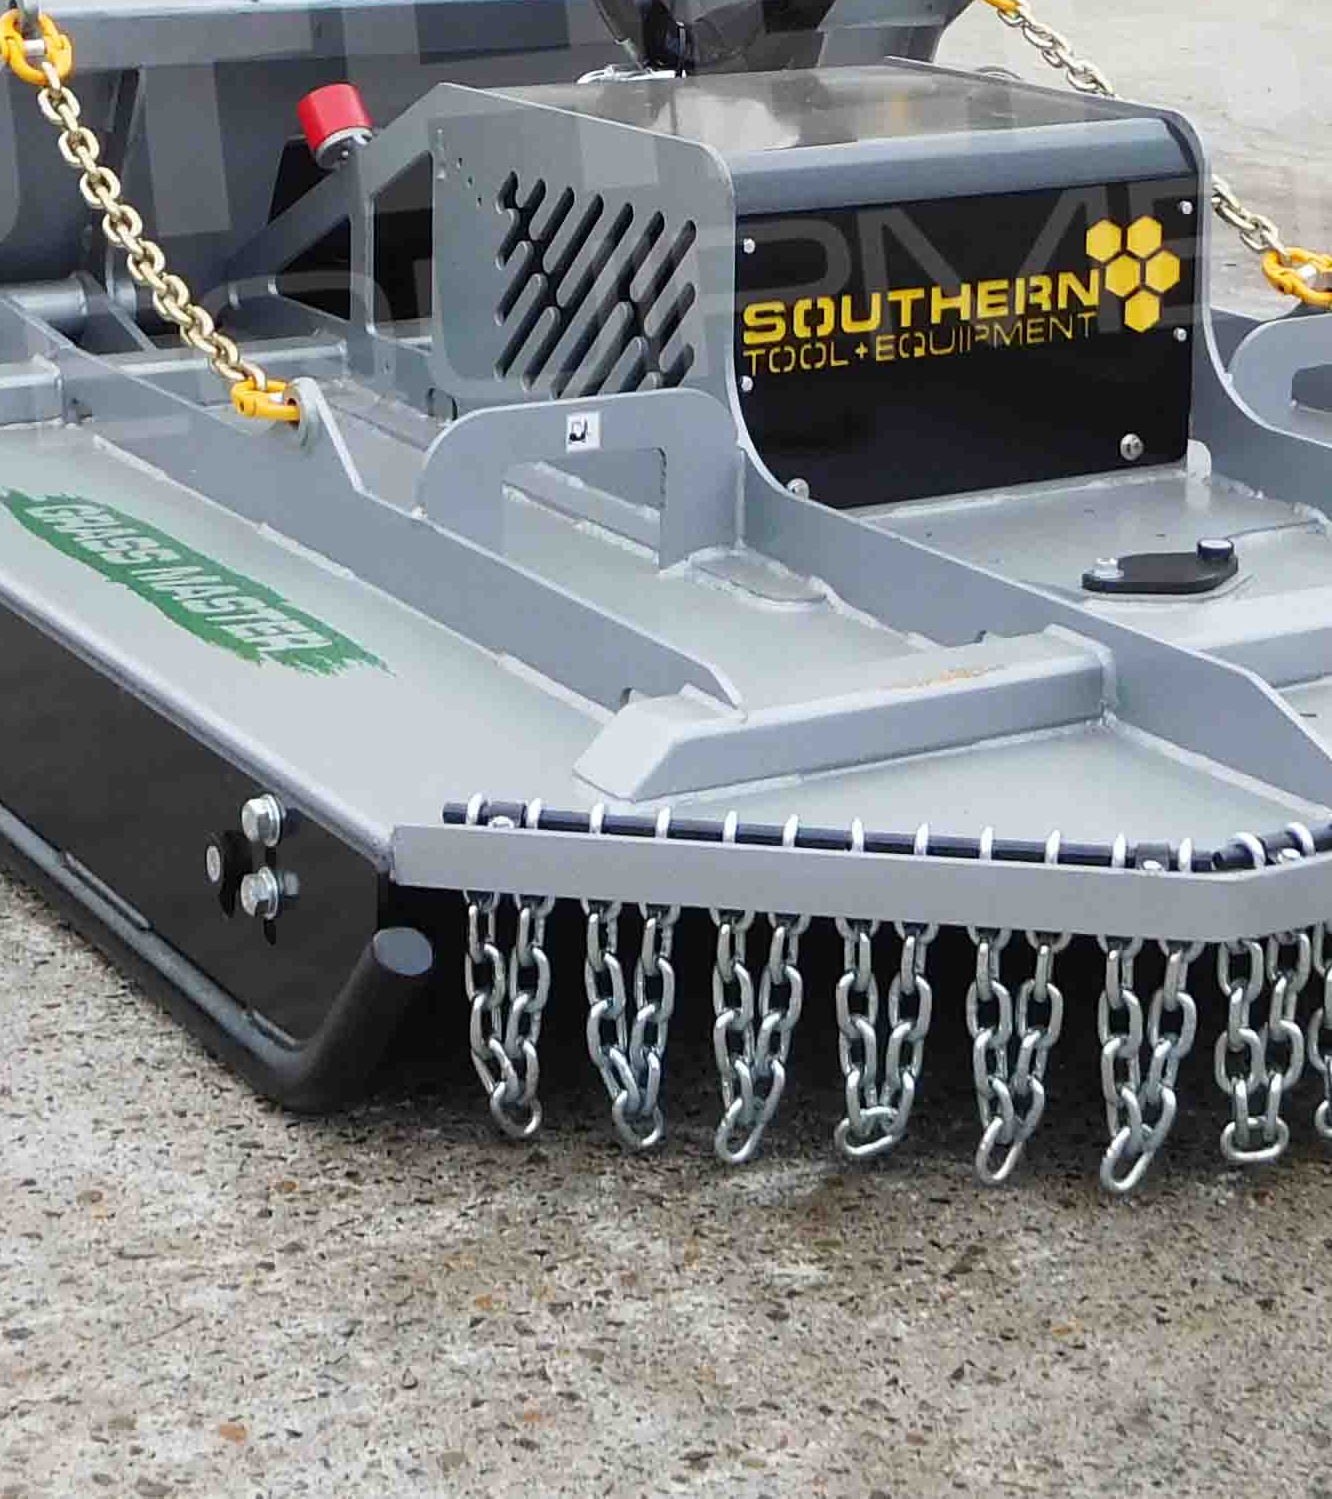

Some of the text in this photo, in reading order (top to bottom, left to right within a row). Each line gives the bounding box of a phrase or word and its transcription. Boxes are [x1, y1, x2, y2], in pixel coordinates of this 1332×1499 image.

[742, 269, 1101, 345] SOUTHERN
[24, 503, 334, 653] GRASS MASTER
